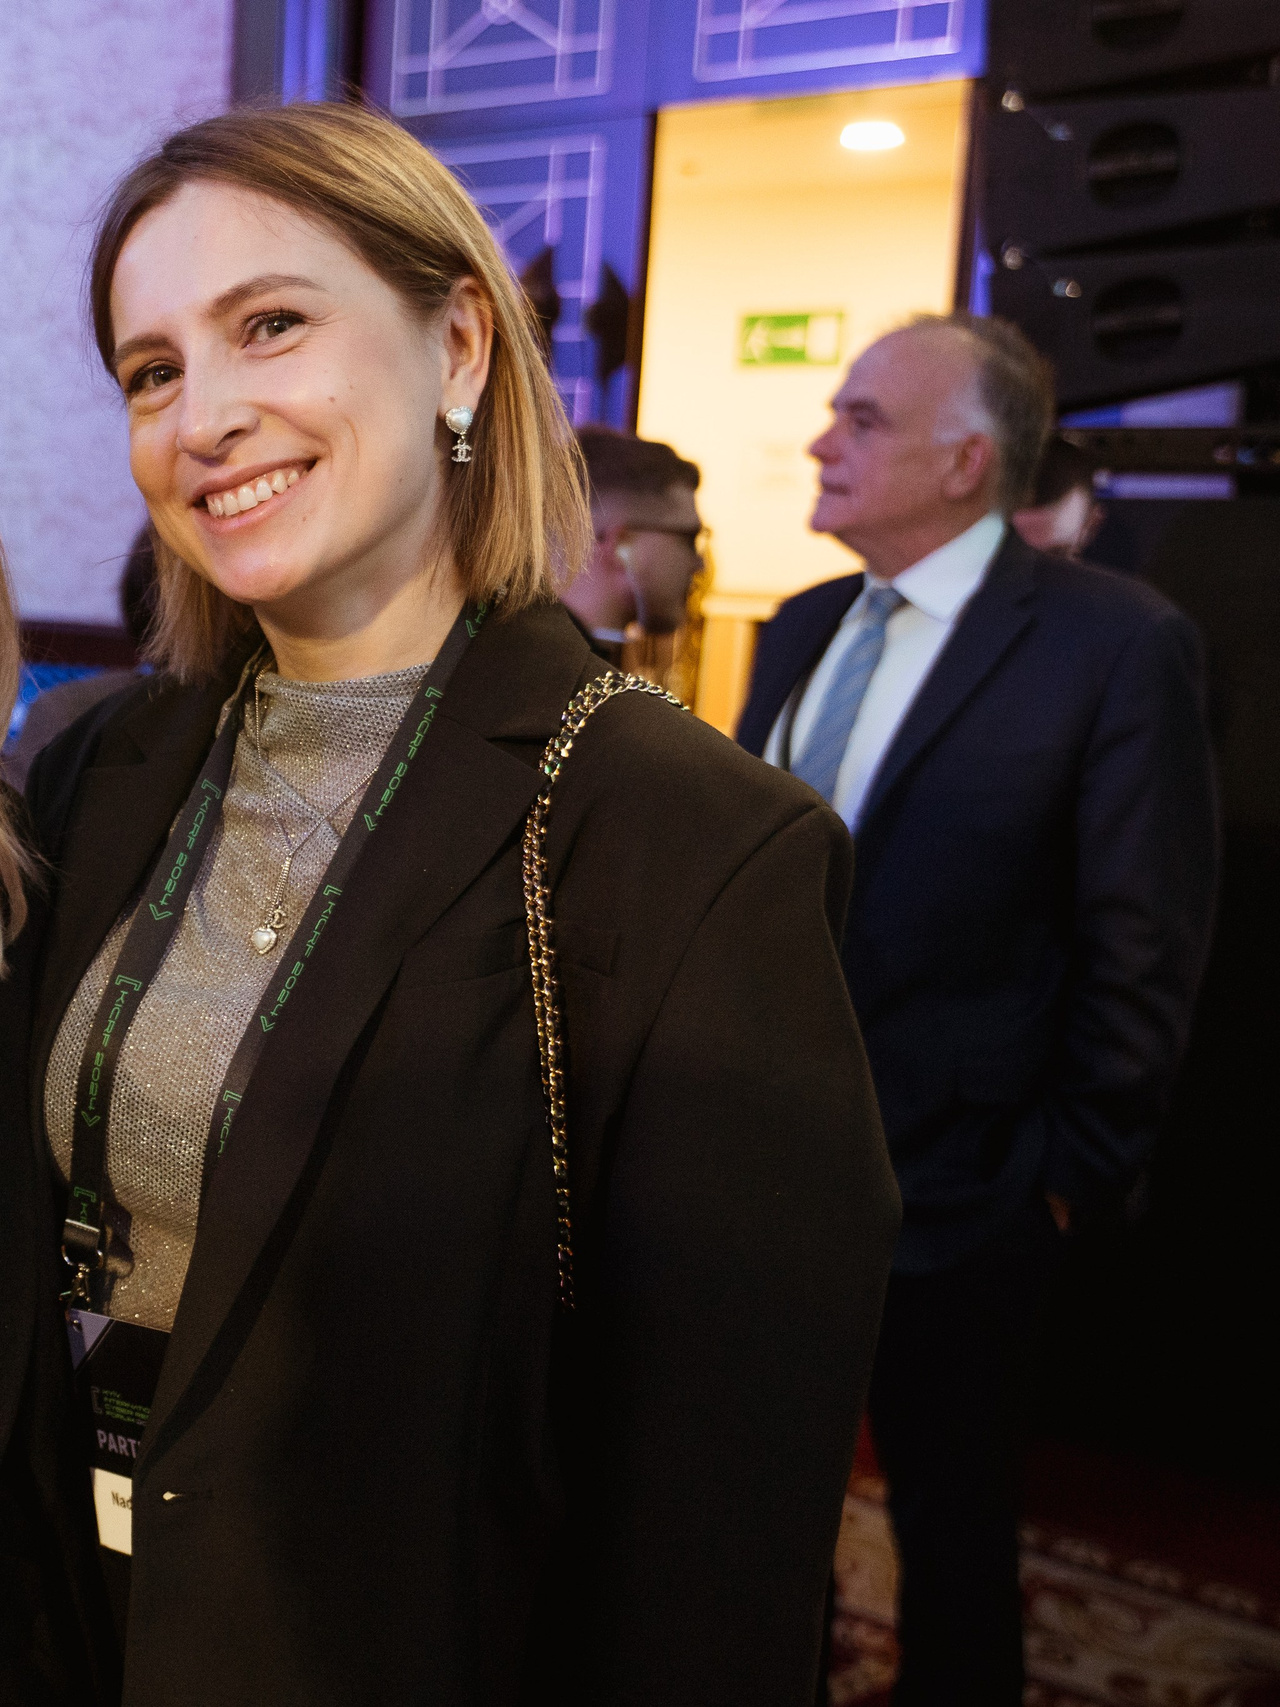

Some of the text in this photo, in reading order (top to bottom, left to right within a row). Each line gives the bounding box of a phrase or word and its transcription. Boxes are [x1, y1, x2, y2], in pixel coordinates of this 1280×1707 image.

[375, 703, 438, 816] KICRF 2024
[159, 795, 211, 906] KICRF 2024
[270, 901, 335, 1016] KICRF 2024
[88, 990, 129, 1111] KICRF 2024
[96, 1429, 140, 1459] PART
